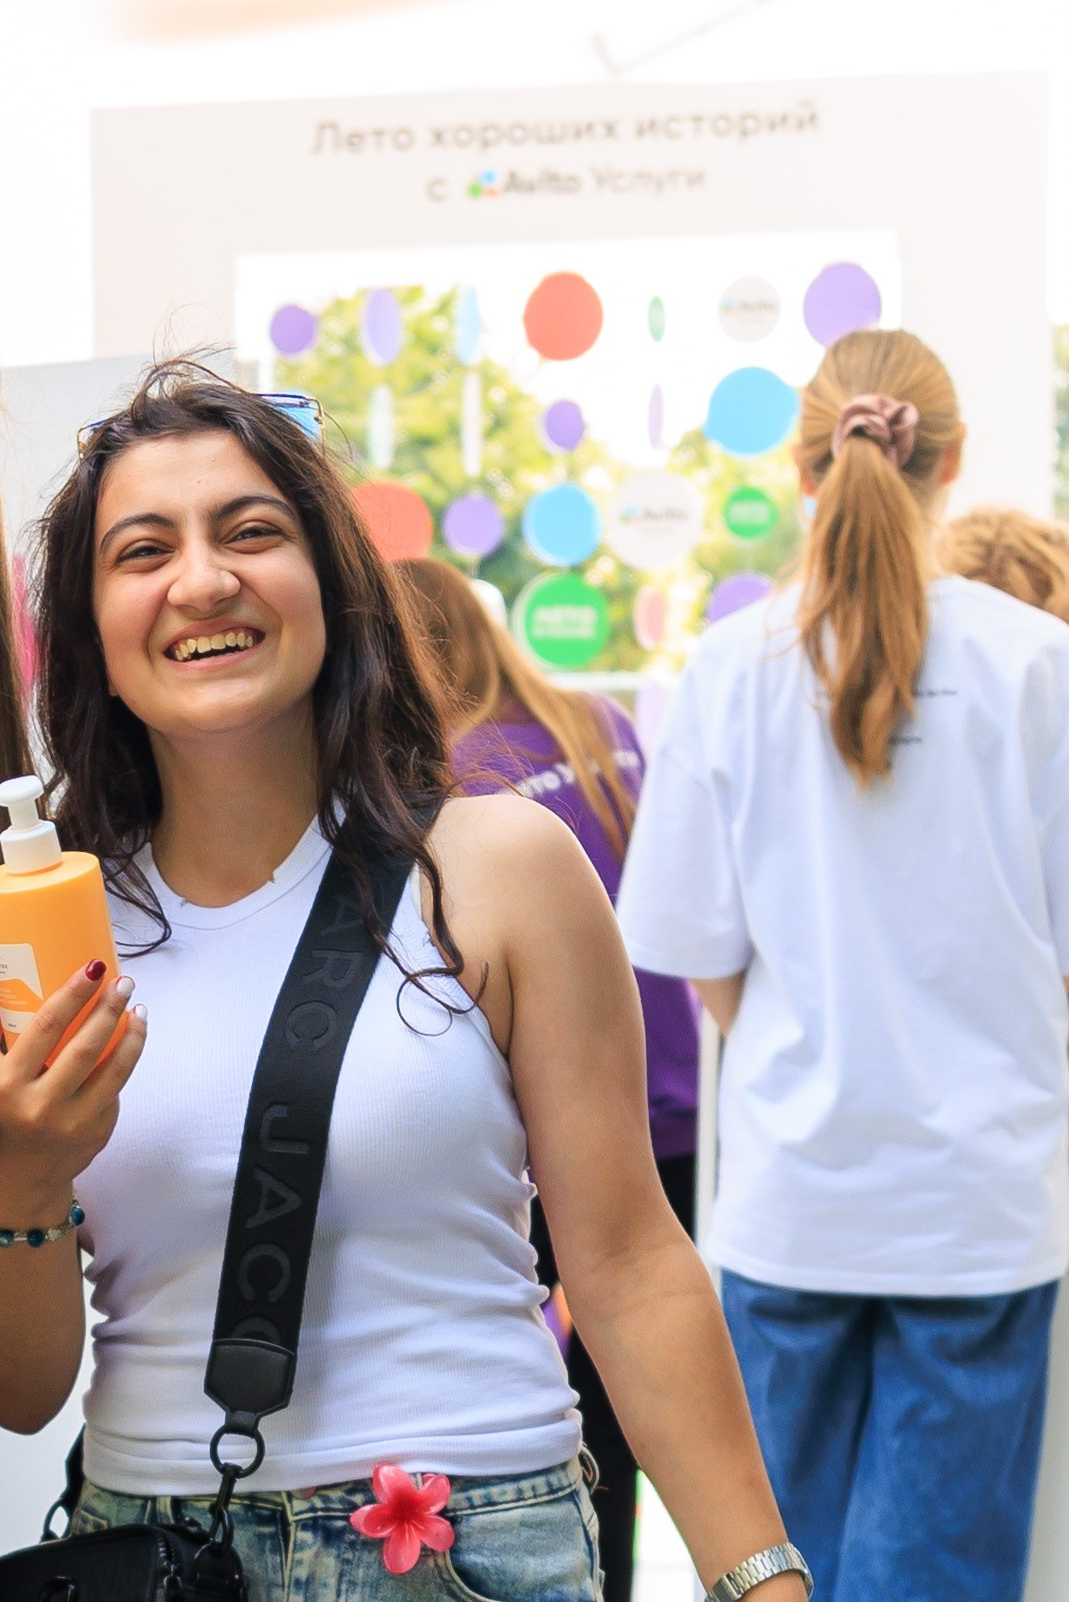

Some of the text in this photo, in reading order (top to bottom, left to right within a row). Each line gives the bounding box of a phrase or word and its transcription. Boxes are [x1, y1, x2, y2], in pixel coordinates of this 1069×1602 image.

[311, 98, 820, 155] Лето хороших историй
[503, 168, 581, 195] Avito
[590, 166, 706, 198] Услуги
[283, 868, 380, 1053] ARC
